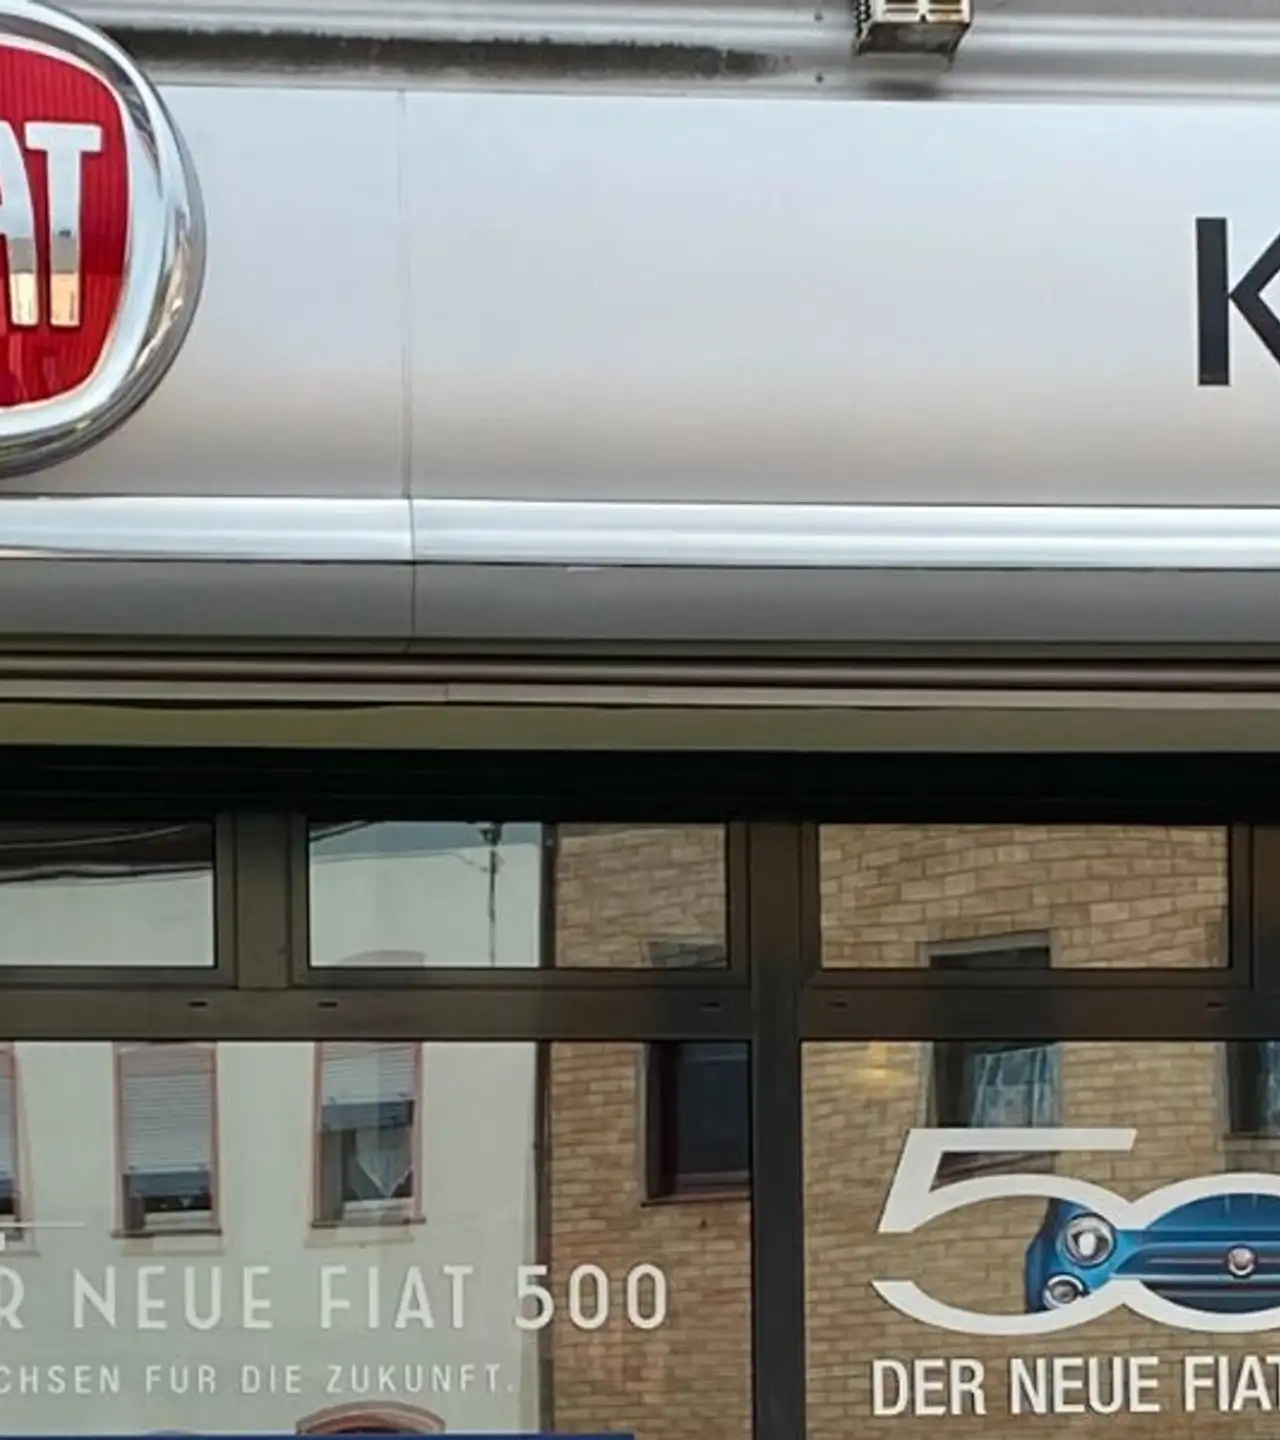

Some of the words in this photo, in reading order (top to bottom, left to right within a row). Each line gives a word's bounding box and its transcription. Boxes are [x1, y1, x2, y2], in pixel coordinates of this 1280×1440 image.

[74, 1264, 274, 1331] NEUE
[320, 1264, 475, 1331] FIAT
[514, 1263, 670, 1332] 500
[241, 1364, 303, 1394] DIE
[326, 1364, 515, 1395] ZUKUNFT.
[871, 1357, 987, 1417] DER
[1009, 1356, 1160, 1414] NEUE
